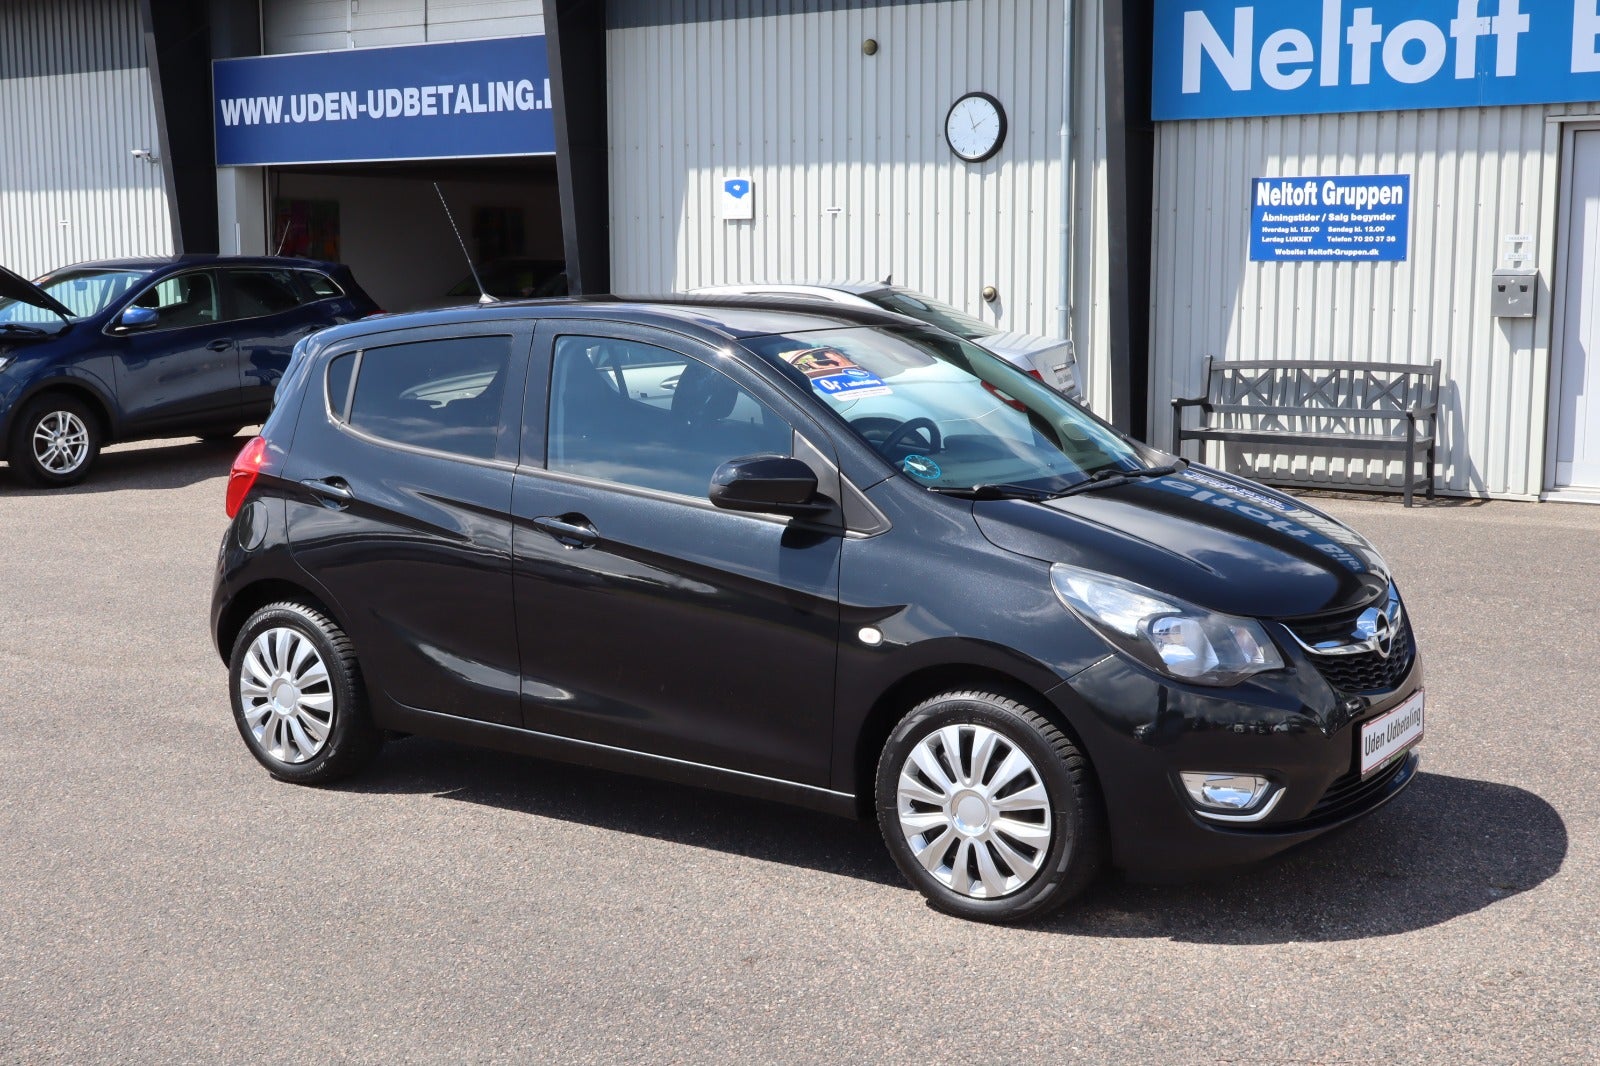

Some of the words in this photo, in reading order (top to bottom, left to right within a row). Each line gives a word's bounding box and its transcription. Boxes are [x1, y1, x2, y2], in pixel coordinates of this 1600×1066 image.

[1182, 0, 1530, 94] Neltoft
[1257, 181, 1318, 206] Neltoft
[1323, 181, 1403, 209] Gruppen
[1328, 213, 1349, 222] Salg
[1351, 213, 1396, 222] begynder
[1365, 732, 1384, 755] Uden
[1387, 708, 1420, 742] Udbetaling
